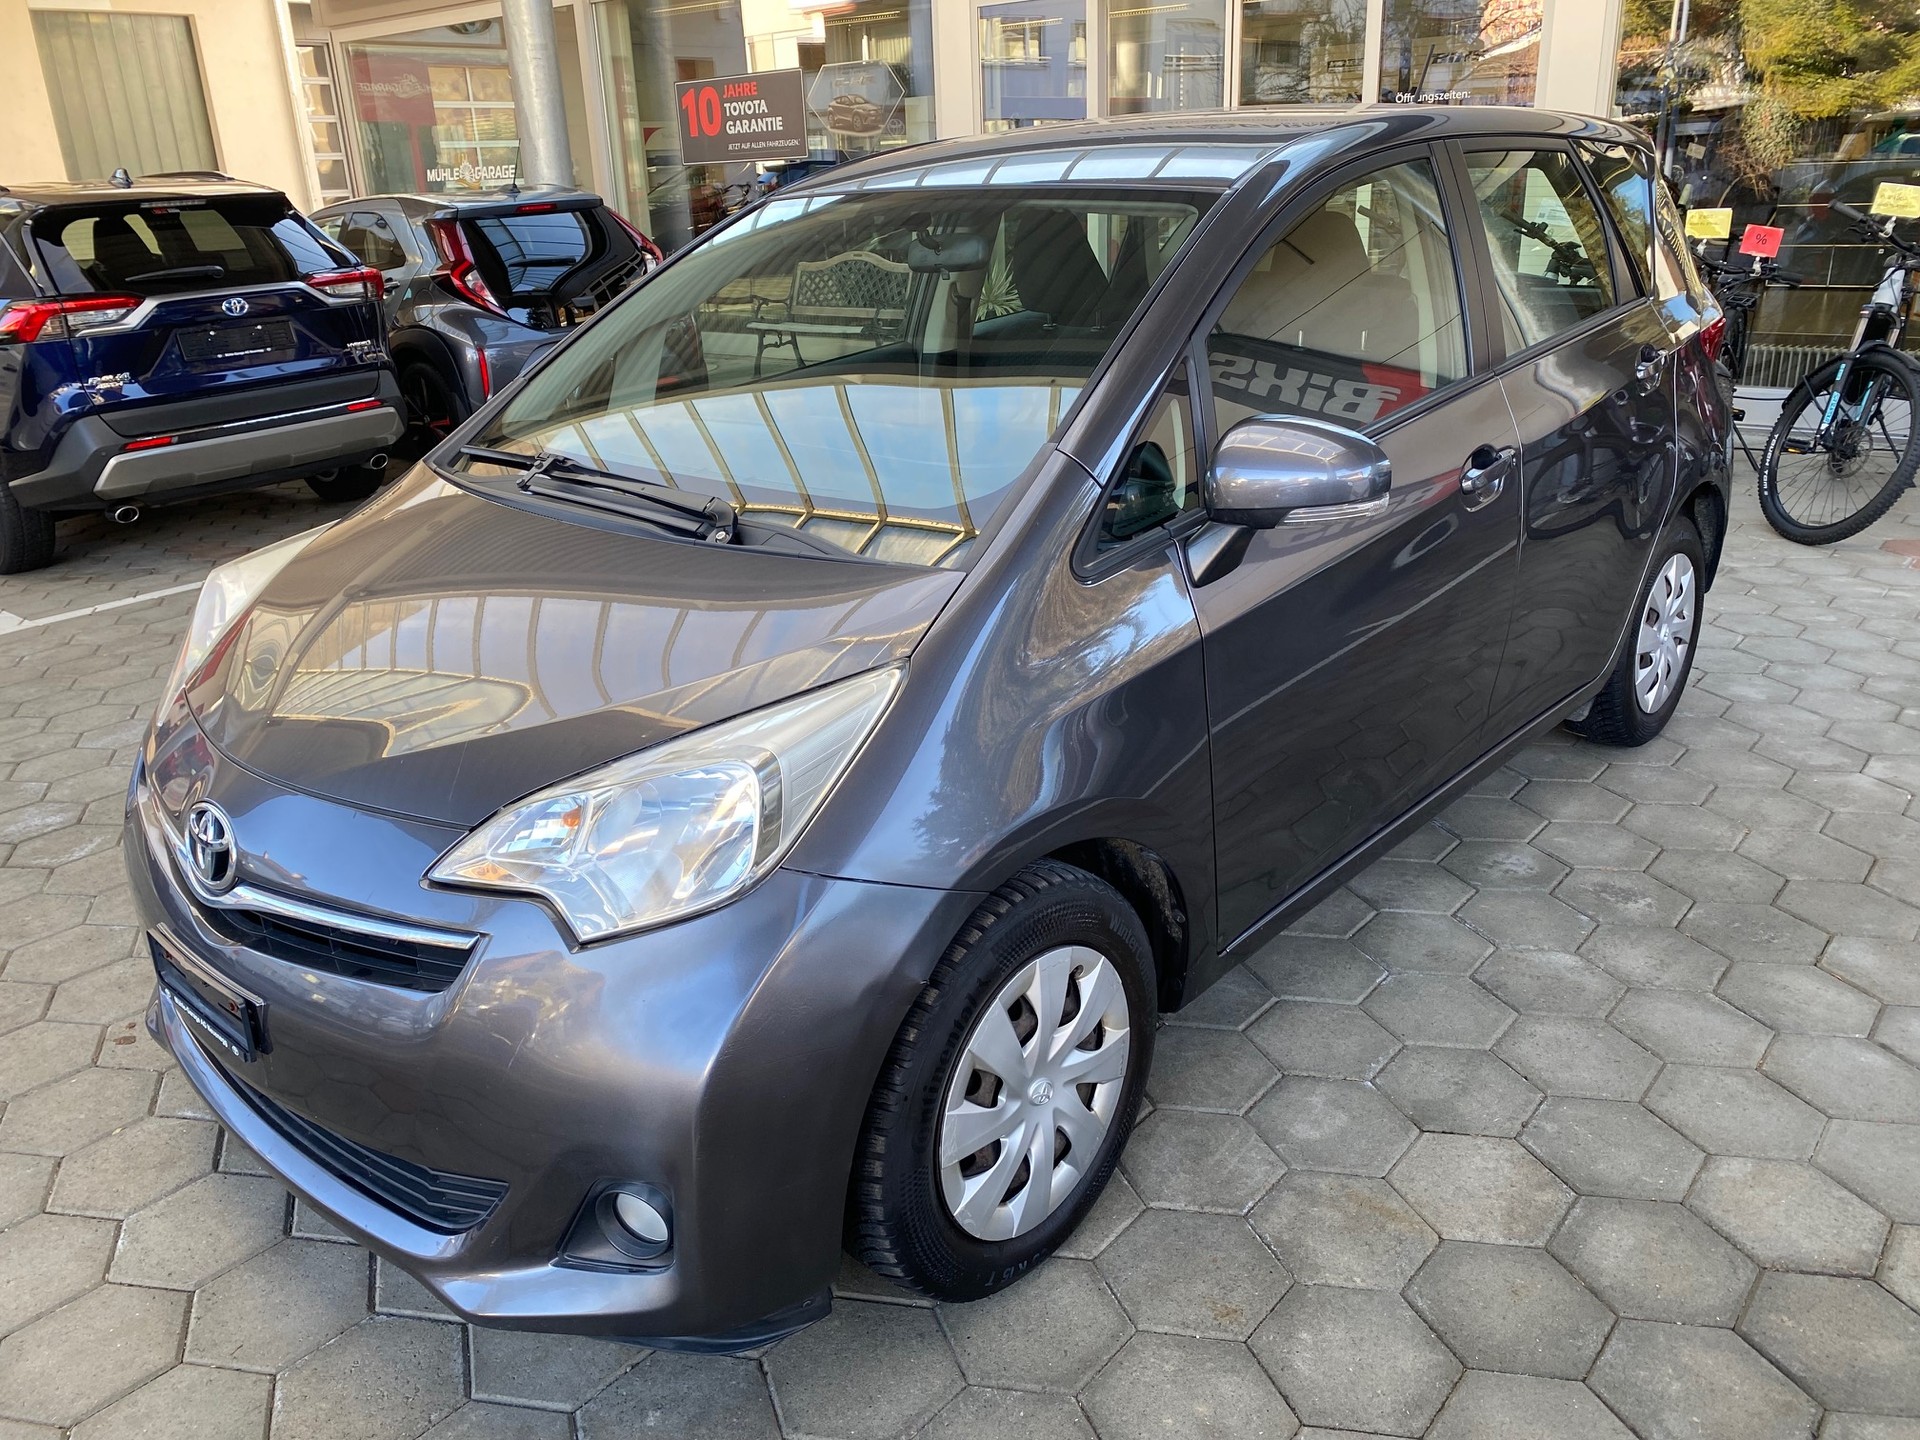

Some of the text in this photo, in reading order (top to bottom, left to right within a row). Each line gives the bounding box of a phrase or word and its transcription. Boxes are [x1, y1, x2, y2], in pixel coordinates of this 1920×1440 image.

[723, 82, 758, 98] JAHRE
[682, 86, 721, 137] 10
[724, 100, 768, 116] TOYOTA
[726, 117, 783, 134] GARANTIE
[728, 143, 740, 151] JETZT
[751, 141, 766, 149] ALLEN
[475, 164, 516, 179] GARAGE
[1756, 233, 1767, 245] %
